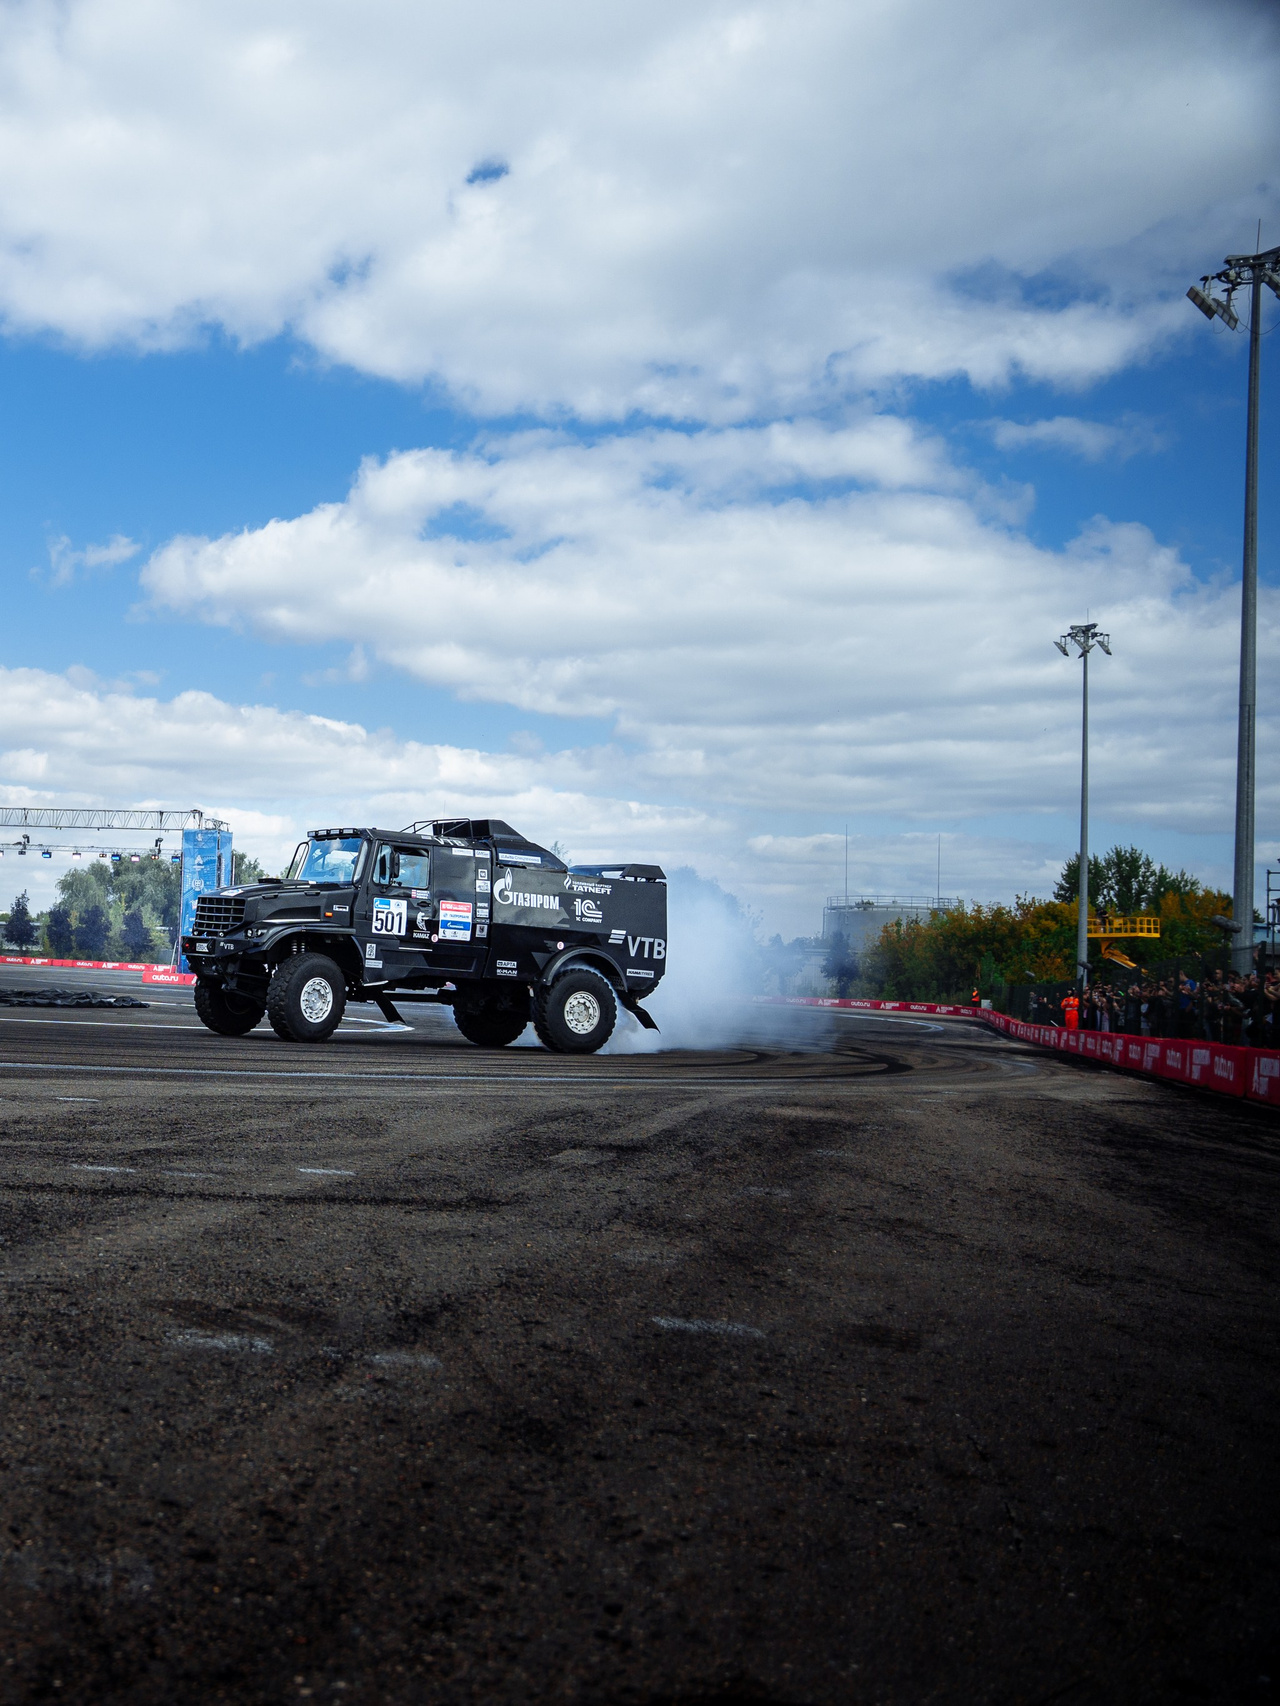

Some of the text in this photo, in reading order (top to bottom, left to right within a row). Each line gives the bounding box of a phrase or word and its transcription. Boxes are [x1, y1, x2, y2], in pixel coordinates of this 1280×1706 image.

[572, 885, 612, 895] TATNEFT
[513, 891, 560, 910] ГАЗПРОМ
[374, 910, 404, 934] 501
[627, 935, 666, 960] VTB
[152, 974, 179, 982] auto.ru
